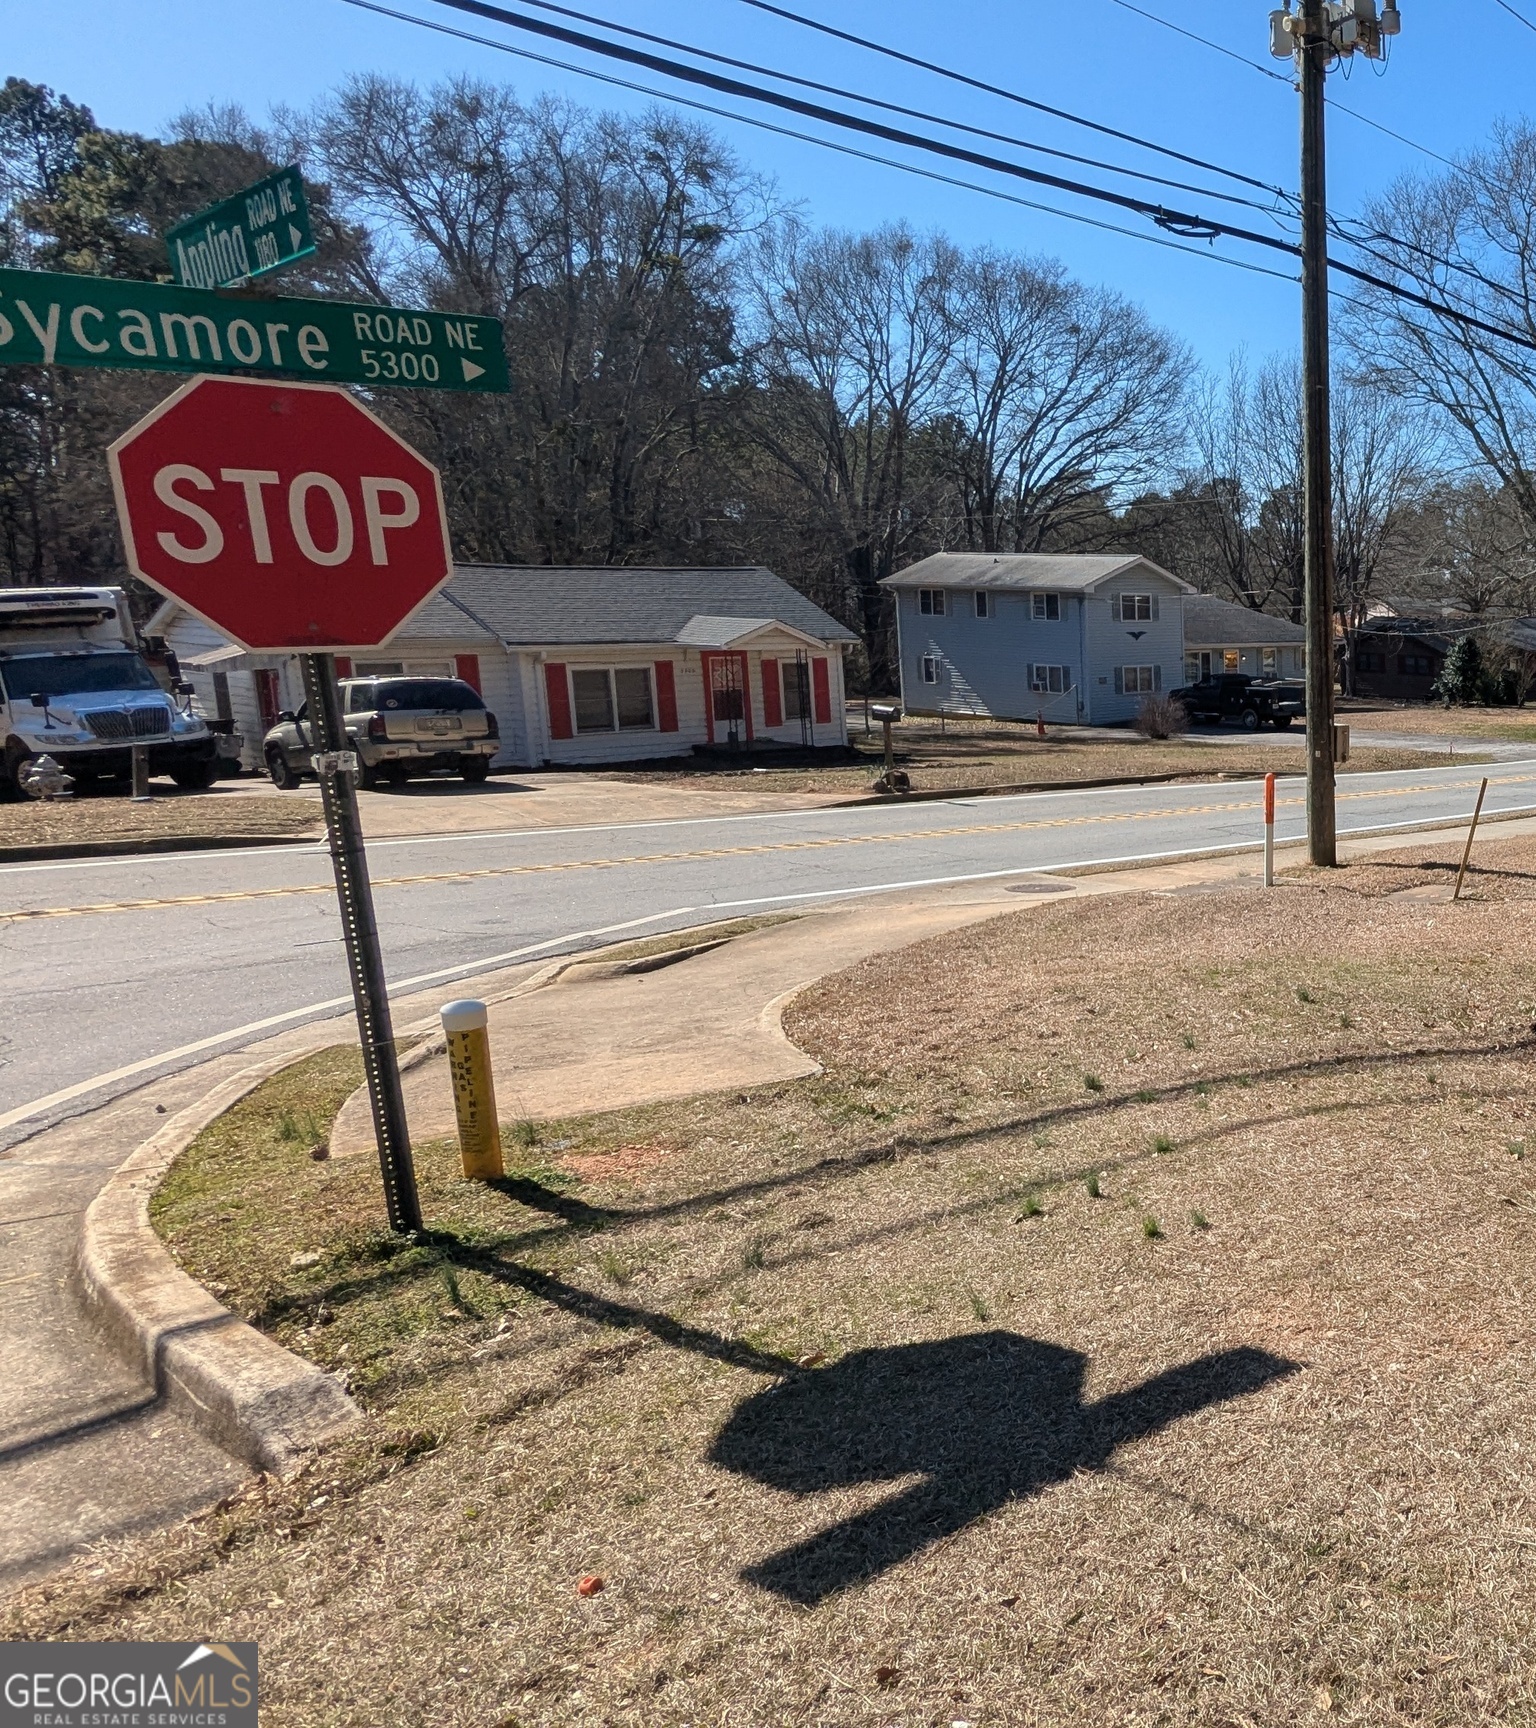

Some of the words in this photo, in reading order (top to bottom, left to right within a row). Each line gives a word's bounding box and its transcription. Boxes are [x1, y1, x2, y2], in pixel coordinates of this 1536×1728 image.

[245, 188, 277, 231] ROAD
[277, 178, 297, 216] NE
[176, 221, 250, 289] Appling
[353, 312, 432, 346] ROAD
[445, 320, 483, 350] NE
[361, 349, 439, 382] 5300
[153, 463, 420, 566] STOP
[457, 1062, 467, 1092] GAS
[461, 1033, 478, 1119] PIPELINE
